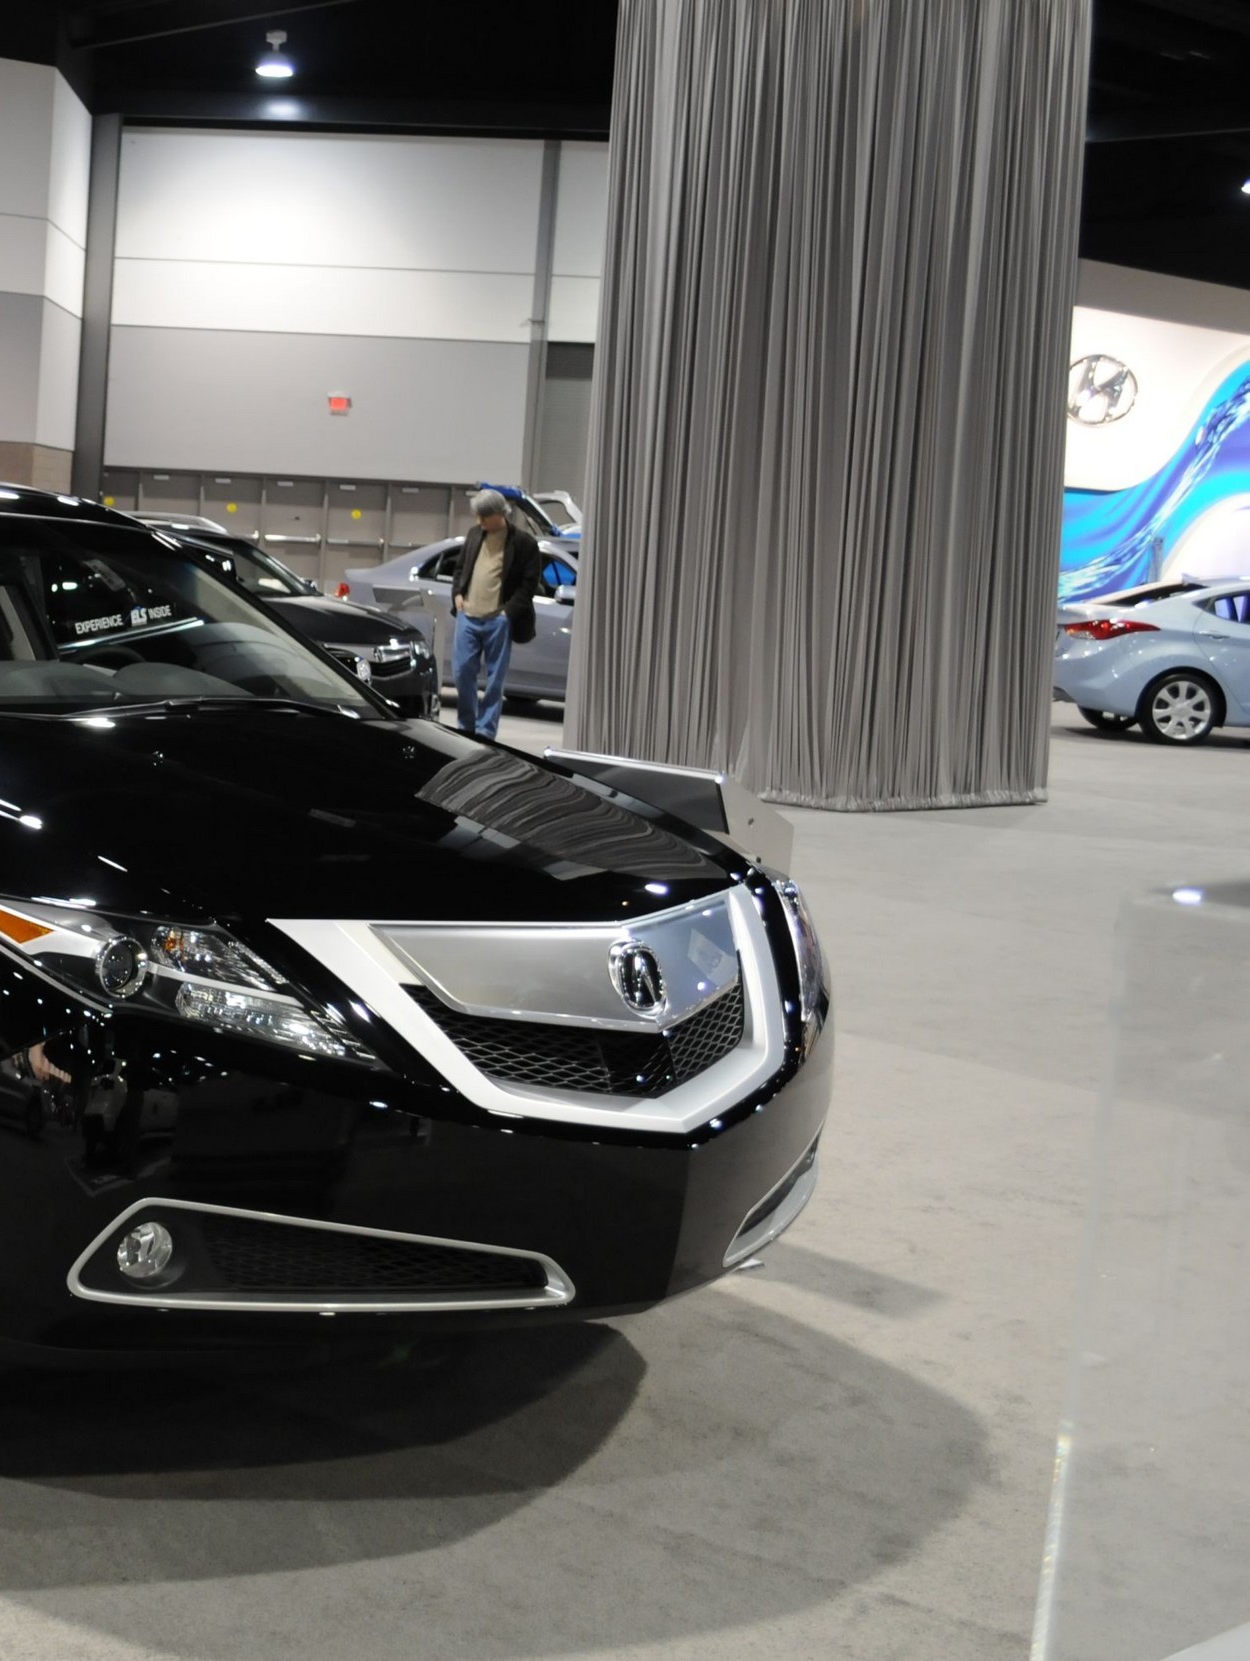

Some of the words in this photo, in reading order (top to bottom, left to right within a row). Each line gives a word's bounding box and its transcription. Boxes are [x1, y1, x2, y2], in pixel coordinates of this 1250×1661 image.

[75, 614, 123, 635] EXPERIENCE
[130, 608, 147, 625] ELS
[148, 605, 172, 619] INSIDE
